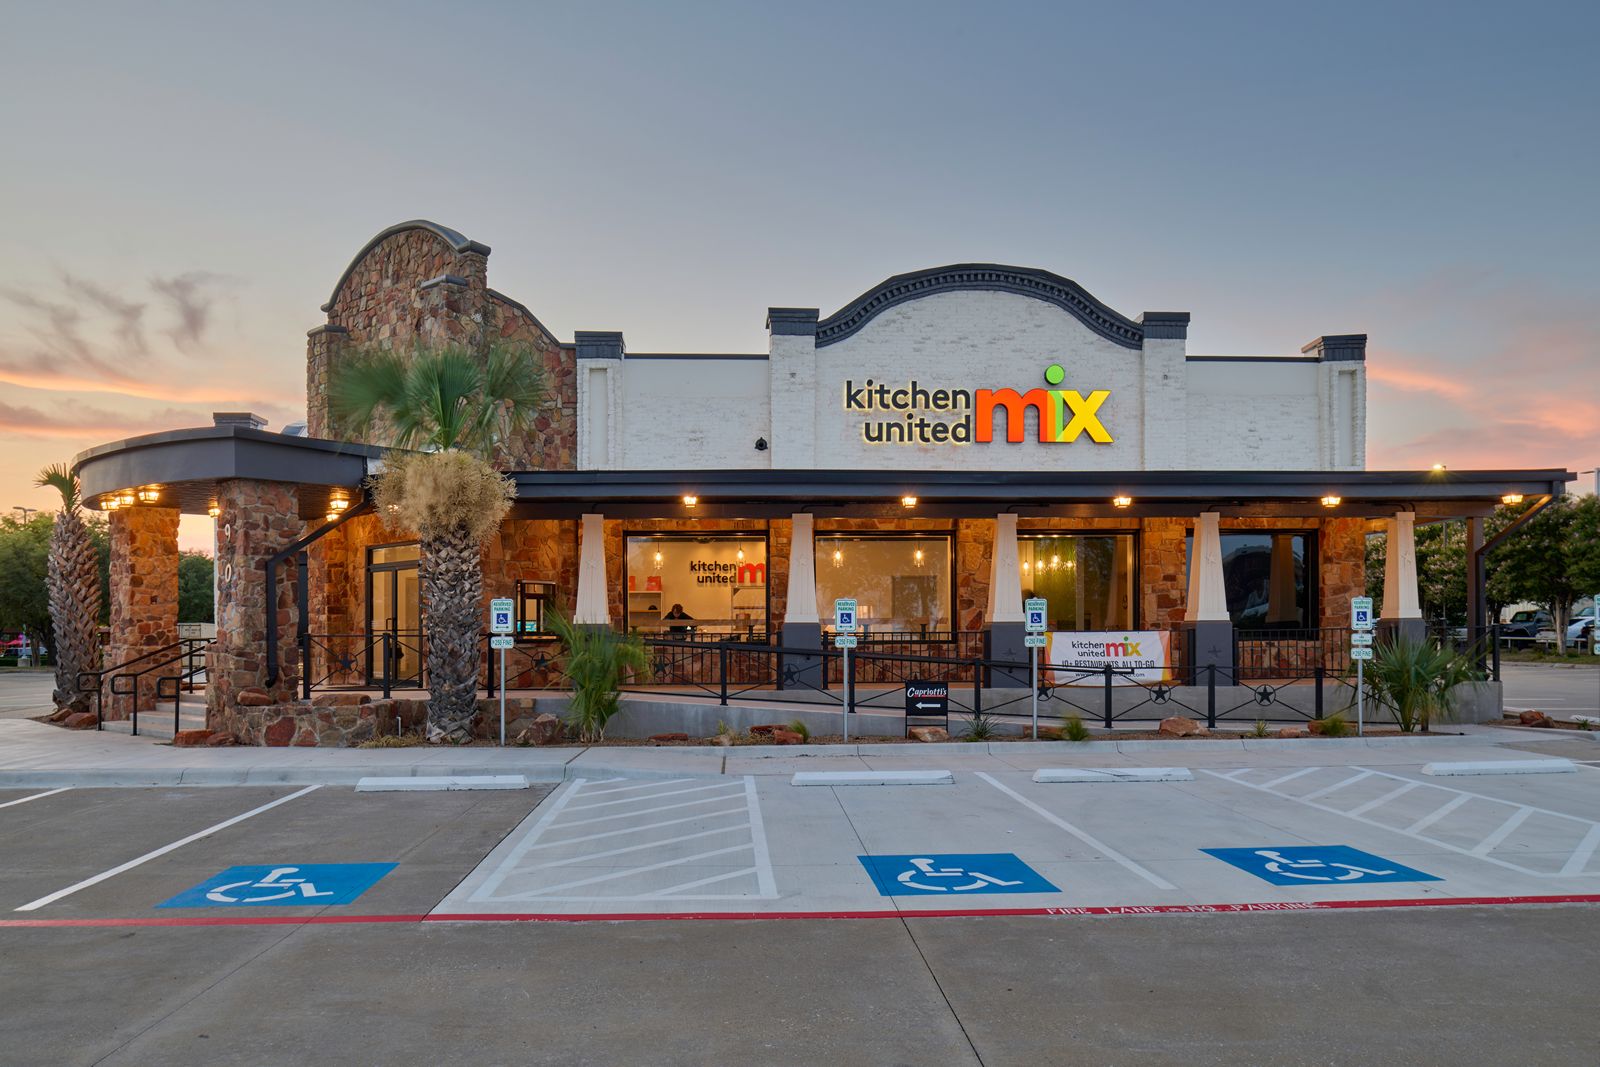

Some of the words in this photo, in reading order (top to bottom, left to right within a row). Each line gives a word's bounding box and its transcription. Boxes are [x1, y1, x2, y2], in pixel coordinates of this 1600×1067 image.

[846, 379, 971, 409] kitchen
[975, 364, 1114, 443] mix
[864, 413, 971, 443] united
[690, 561, 737, 572] kitchen
[697, 573, 737, 583] united
[1071, 640, 1105, 649] kitchen
[1105, 636, 1142, 657] mix
[907, 687, 947, 698] Capriotti's
[1104, 906, 1160, 914] LANE
